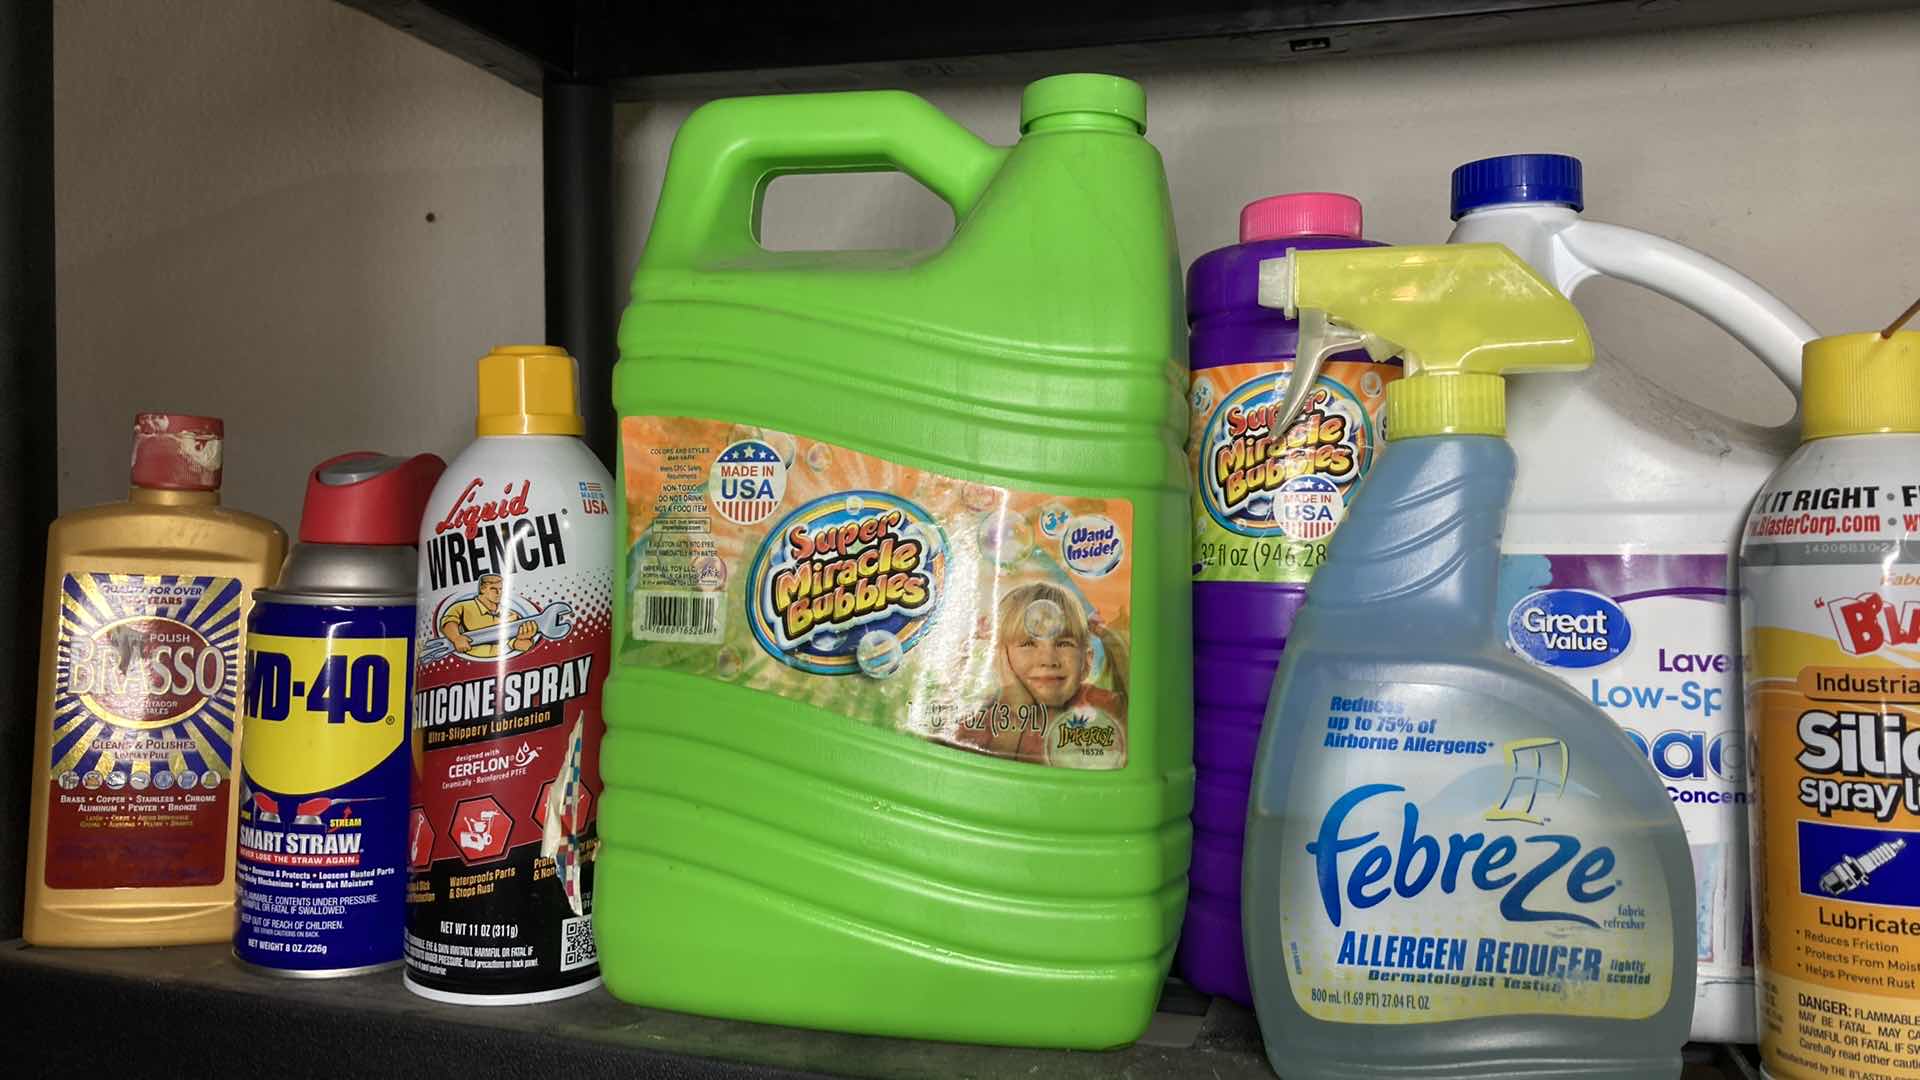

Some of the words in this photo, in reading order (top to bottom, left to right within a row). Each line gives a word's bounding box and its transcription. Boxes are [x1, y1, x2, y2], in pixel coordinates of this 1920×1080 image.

[1227, 389, 1327, 435] Supr
[720, 466, 759, 477] MADE
[762, 465, 775, 477] IN
[721, 479, 775, 501] USA
[1284, 495, 1316, 504] MADE
[1320, 495, 1332, 504] IN
[1771, 491, 1793, 513] IT
[1792, 486, 1880, 512] RIGHT
[435, 477, 531, 539] Liquid
[582, 498, 609, 515] USA
[673, 505, 692, 513] FOOD
[692, 505, 708, 513] ITEM
[1284, 506, 1334, 521] USA
[1045, 511, 1069, 531] 3+
[789, 509, 902, 560] Super
[1071, 525, 1114, 545] Wand
[426, 512, 567, 592] WRENCH
[1067, 538, 1120, 561] Inside!
[1230, 548, 1249, 567] oz
[671, 565, 682, 573] TOY
[773, 537, 922, 614] Miracle
[149, 586, 172, 595] FOR
[173, 586, 203, 596] OVER
[785, 571, 928, 639] Bubbles
[1521, 607, 1609, 635] Great
[149, 632, 191, 643] POLISH
[1543, 631, 1609, 652] Value
[66, 638, 226, 696] BRASSO
[503, 655, 592, 713] SPRAY
[1330, 695, 1406, 714] Reduces
[428, 723, 488, 744] Ultra-Slippery
[490, 710, 551, 733] Lubrication
[991, 703, 1048, 737] (3.9L)
[1327, 716, 1350, 731] up
[1355, 716, 1373, 731] to
[1375, 716, 1414, 734] 75%
[1417, 718, 1438, 734] of
[134, 741, 144, 750] &
[145, 740, 197, 751] POLISHES
[1323, 732, 1399, 751] Airborne
[456, 752, 484, 763] designed
[484, 748, 500, 757] with
[449, 755, 510, 779] CERFLON
[510, 767, 528, 777] PTFE
[60, 795, 86, 804] BRASS
[96, 795, 126, 804] COPPER
[135, 794, 175, 803] STAINLESS
[184, 793, 217, 803] CHROME
[1799, 777, 1899, 819] spray
[78, 803, 118, 813] ALUMINUM
[128, 803, 158, 813] PEWTER
[167, 803, 199, 812] BRONZE
[329, 818, 362, 828] STREAM
[239, 825, 284, 854] SMART
[286, 832, 363, 855] STRAW
[255, 853, 272, 862] LOSE
[274, 855, 288, 864] THE
[291, 856, 323, 865] STRAW
[281, 870, 311, 880] Protects
[318, 871, 349, 880] Loosens
[350, 869, 375, 879] Rusted
[376, 867, 395, 876] Parts
[449, 872, 494, 887] Waterproofs
[494, 867, 516, 879] Parts
[533, 870, 540, 881] &
[301, 880, 325, 890] Drives
[325, 880, 340, 889] Out
[340, 879, 374, 889] Moisture
[455, 887, 476, 899] Stops
[476, 883, 495, 895] Rust
[261, 903, 271, 913] OR
[271, 903, 289, 914] FATAL
[290, 905, 297, 914] IF
[298, 905, 347, 916] SWALLOWED.
[275, 896, 312, 906] CONTENTS
[312, 897, 339, 906] UNDER
[1617, 904, 1645, 918] fabric
[262, 918, 271, 927] OF
[271, 919, 293, 930] REACH
[294, 920, 305, 930] OF
[305, 920, 345, 931] CHILDREN.
[440, 920, 454, 934] NET
[455, 923, 468, 936] WT
[468, 924, 478, 937] 11
[480, 924, 491, 938] OZ
[492, 923, 519, 939] (311g)
[1603, 915, 1646, 930] refresher
[296, 930, 305, 938] ON
[1804, 930, 1850, 948] Reduces
[1852, 937, 1900, 954] Friction
[248, 938, 258, 949] NET
[259, 940, 285, 952] WEIGHT
[285, 943, 291, 952] 8
[501, 946, 511, 958] OR
[1336, 930, 1468, 972] ALLERGEN
[1475, 937, 1603, 983] REDUCER
[1805, 946, 1850, 964] Protects
[1852, 955, 1885, 969] From
[1609, 959, 1647, 974] lightly
[1368, 969, 1495, 988] Dermatologist
[1606, 972, 1652, 985] scented
[1805, 963, 1836, 979] Helps
[1838, 970, 1884, 986] Prevent
[1887, 975, 1916, 990] Rust
[1311, 988, 1328, 1003] 800
[1328, 991, 1342, 1005] mL
[1343, 990, 1364, 1006] (1.69
[1365, 992, 1380, 1009] PT)
[1405, 995, 1416, 1010] FL
[1418, 995, 1431, 1011] OZ
[1798, 992, 1853, 1017] DANGER:
[1798, 1010, 1817, 1023] MAY
[1821, 1015, 1834, 1028] BE
[1878, 1026, 1902, 1039] MAY
[1798, 1024, 1841, 1044] HARMFUL
[1843, 1035, 1859, 1047] OR
[1861, 1039, 1892, 1052] FATAL
[1894, 1043, 1905, 1054] IF
[1799, 1038, 1837, 1059] Carefully
[1838, 1049, 1861, 1062] read
[1863, 1054, 1890, 1066] other
[1831, 1065, 1847, 1077] THE
